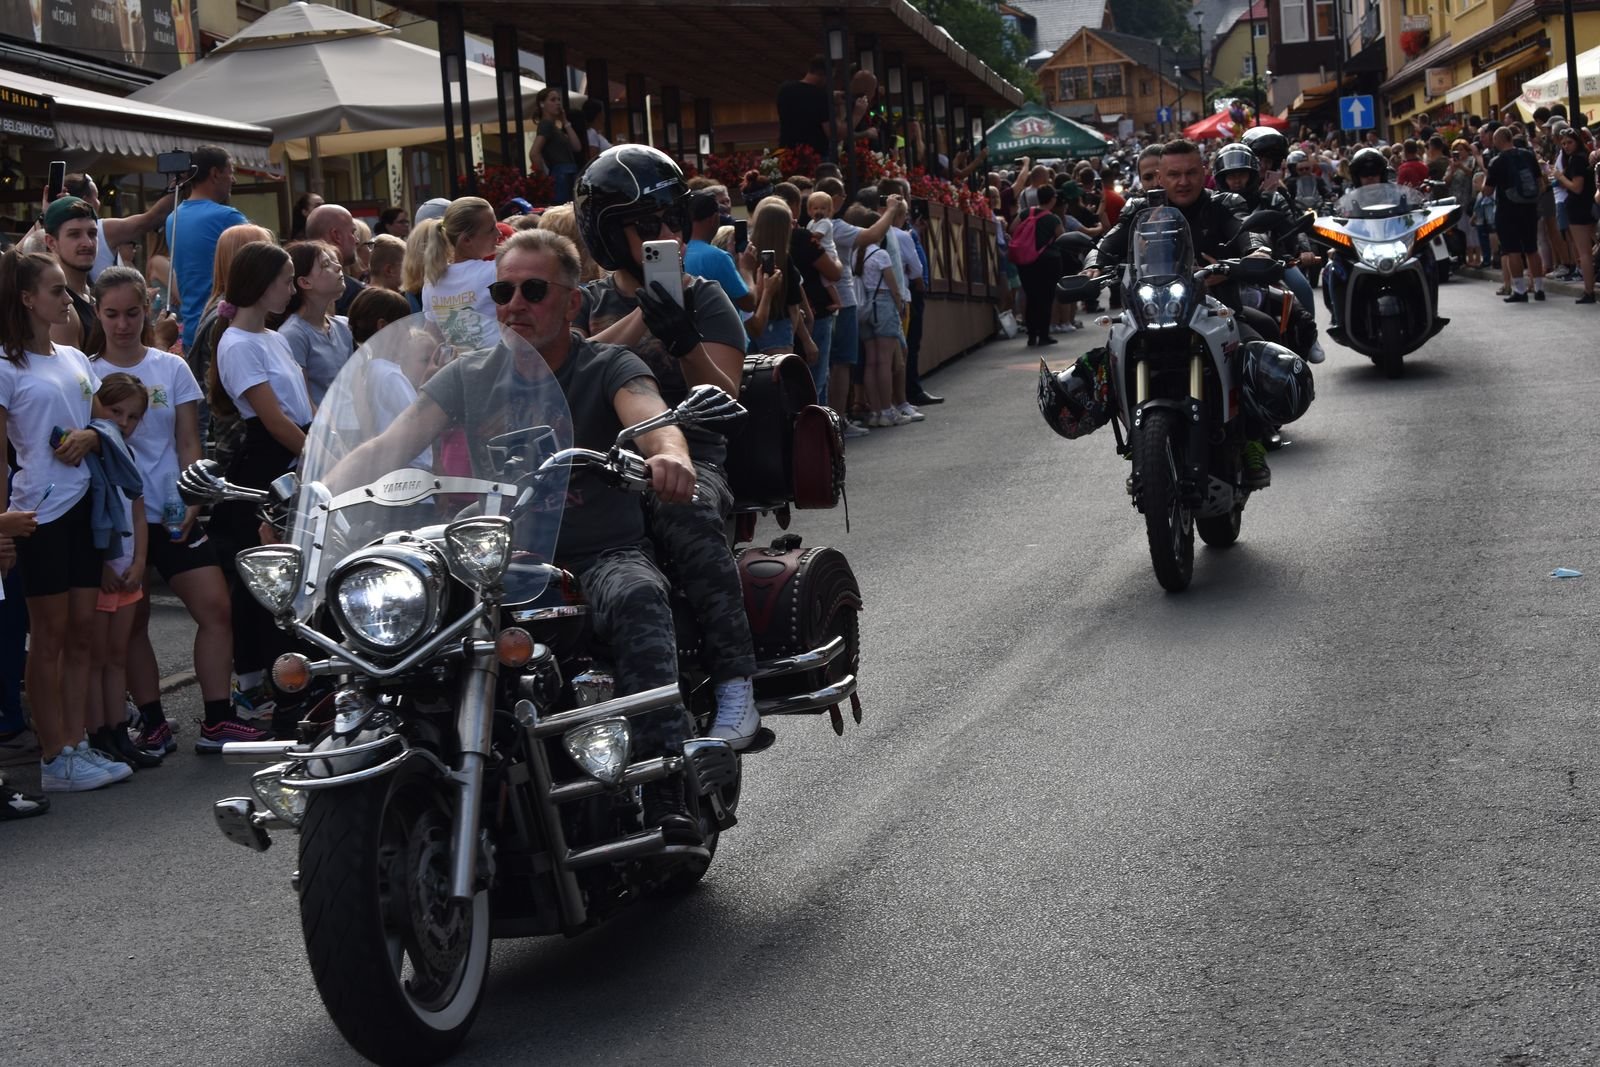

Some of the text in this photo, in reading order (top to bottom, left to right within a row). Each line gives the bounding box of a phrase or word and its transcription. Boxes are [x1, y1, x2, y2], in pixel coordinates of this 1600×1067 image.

[3, 119, 32, 136] BELGIAN
[431, 290, 477, 306] SUMMER
[383, 480, 422, 494] YAMAHA
